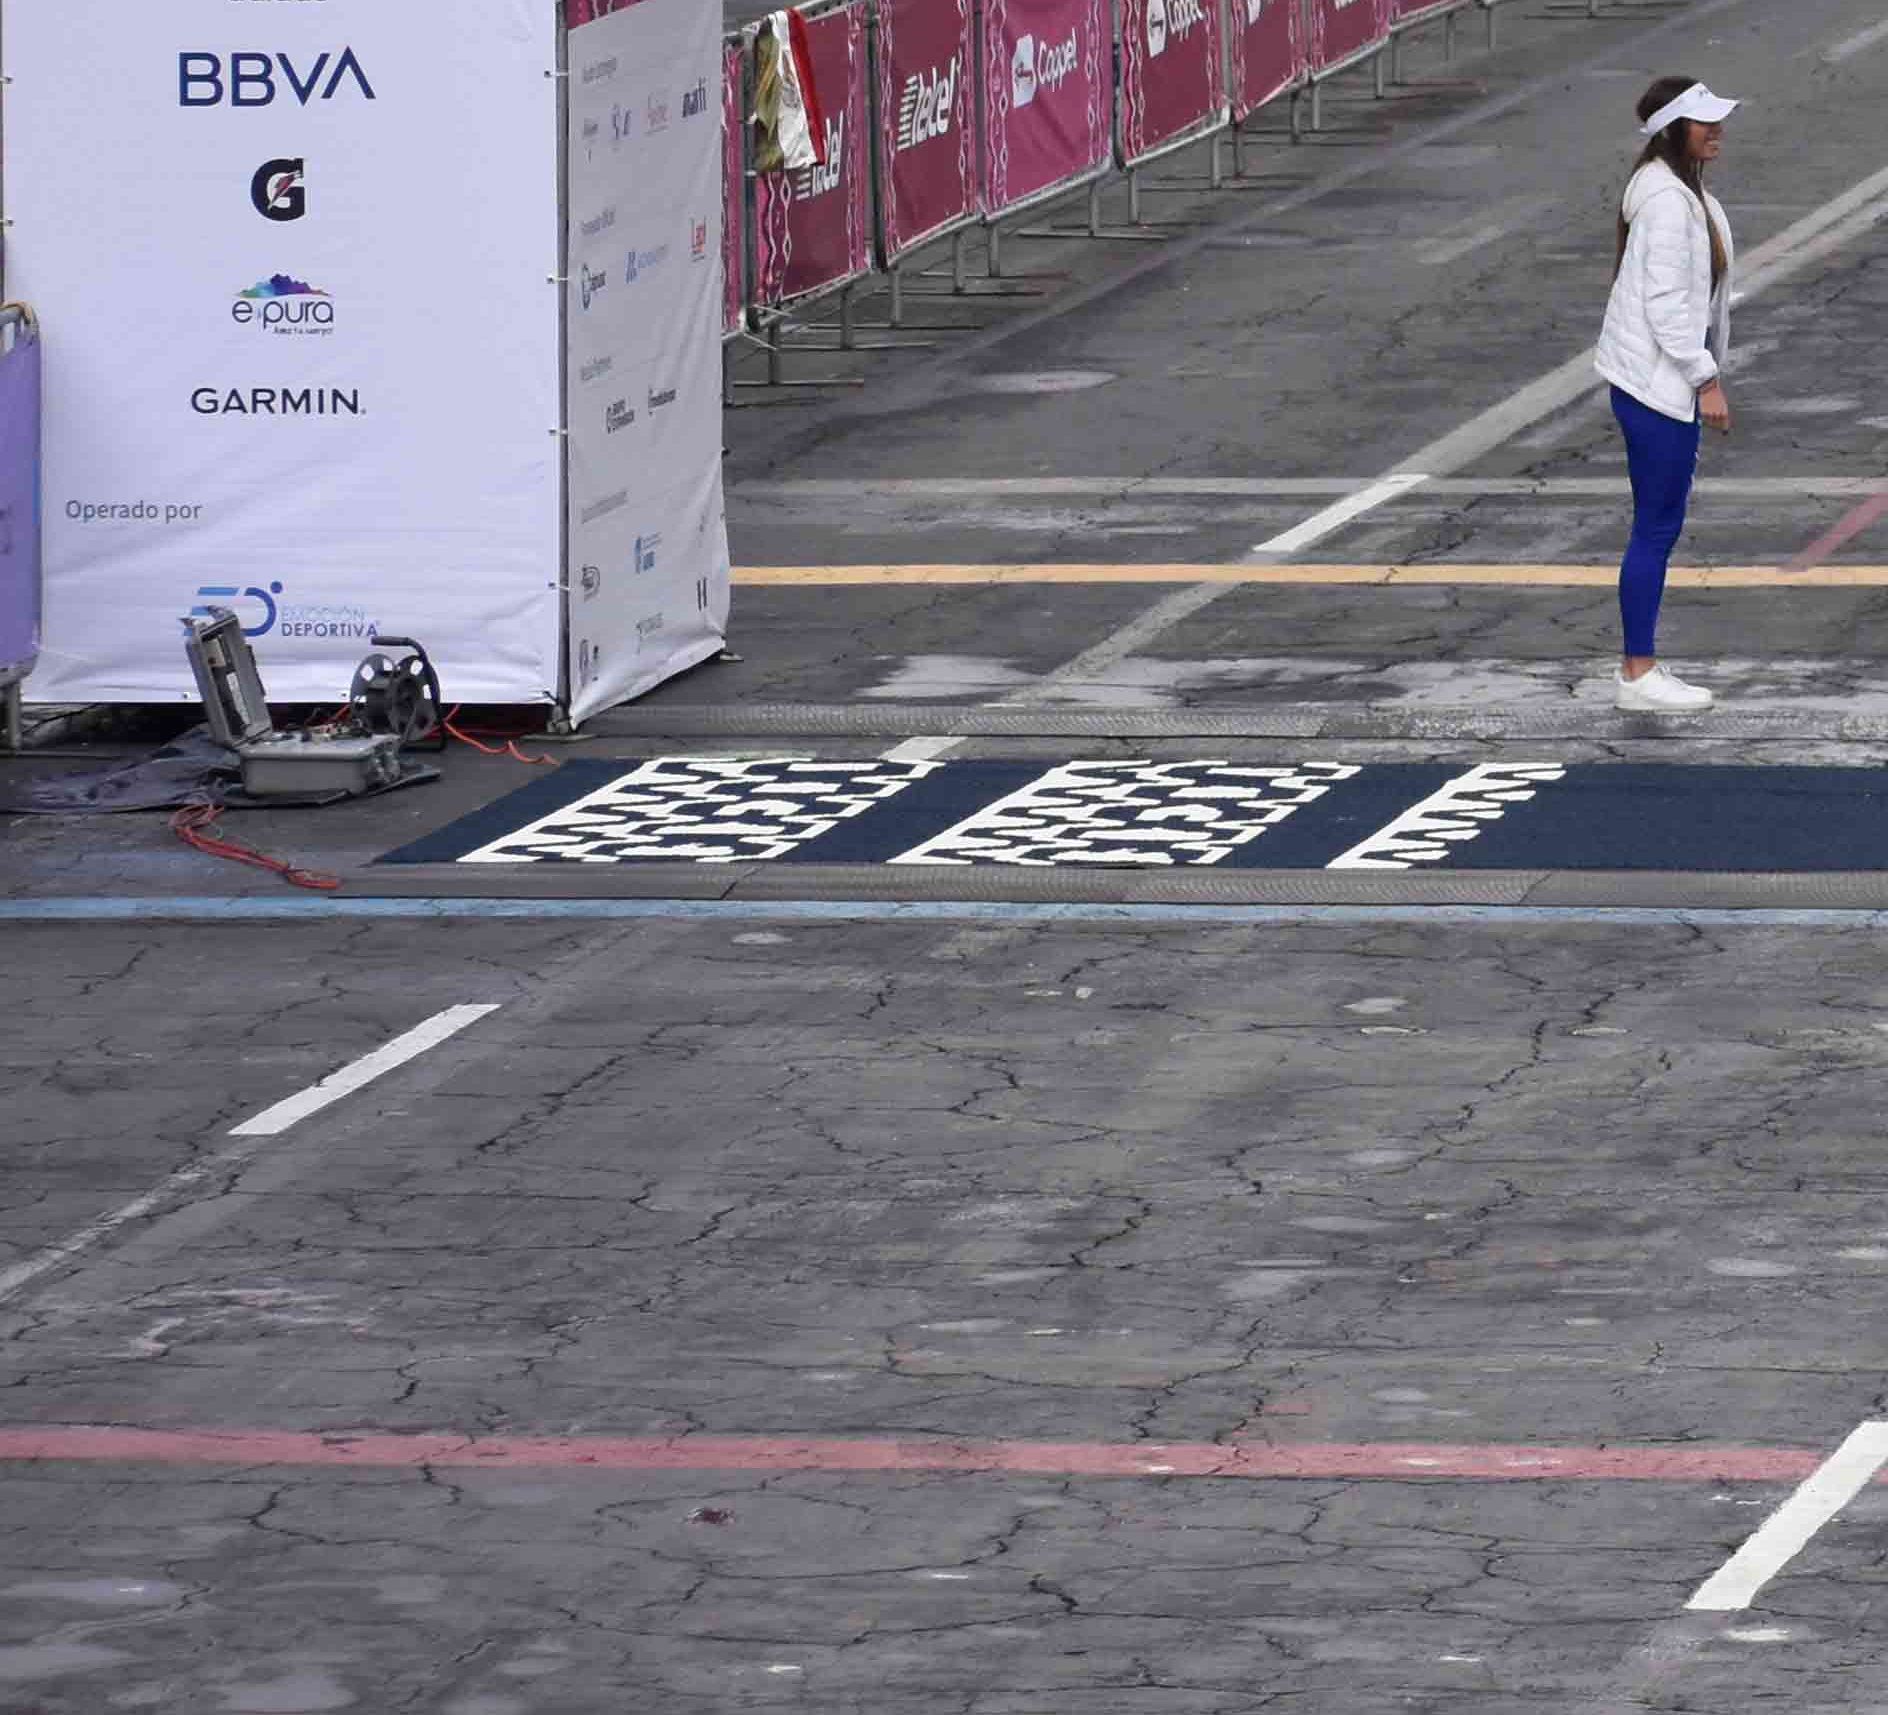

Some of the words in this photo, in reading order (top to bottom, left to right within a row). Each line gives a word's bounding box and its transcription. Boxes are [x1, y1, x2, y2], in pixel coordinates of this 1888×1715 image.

[179, 46, 376, 107] BBVA
[1036, 29, 1079, 89] Coppel
[912, 58, 957, 145] telcel
[191, 388, 360, 415] GARMIN
[65, 500, 158, 523] Operado
[165, 503, 202, 524] por
[281, 622, 378, 637] DEPORTIVA
